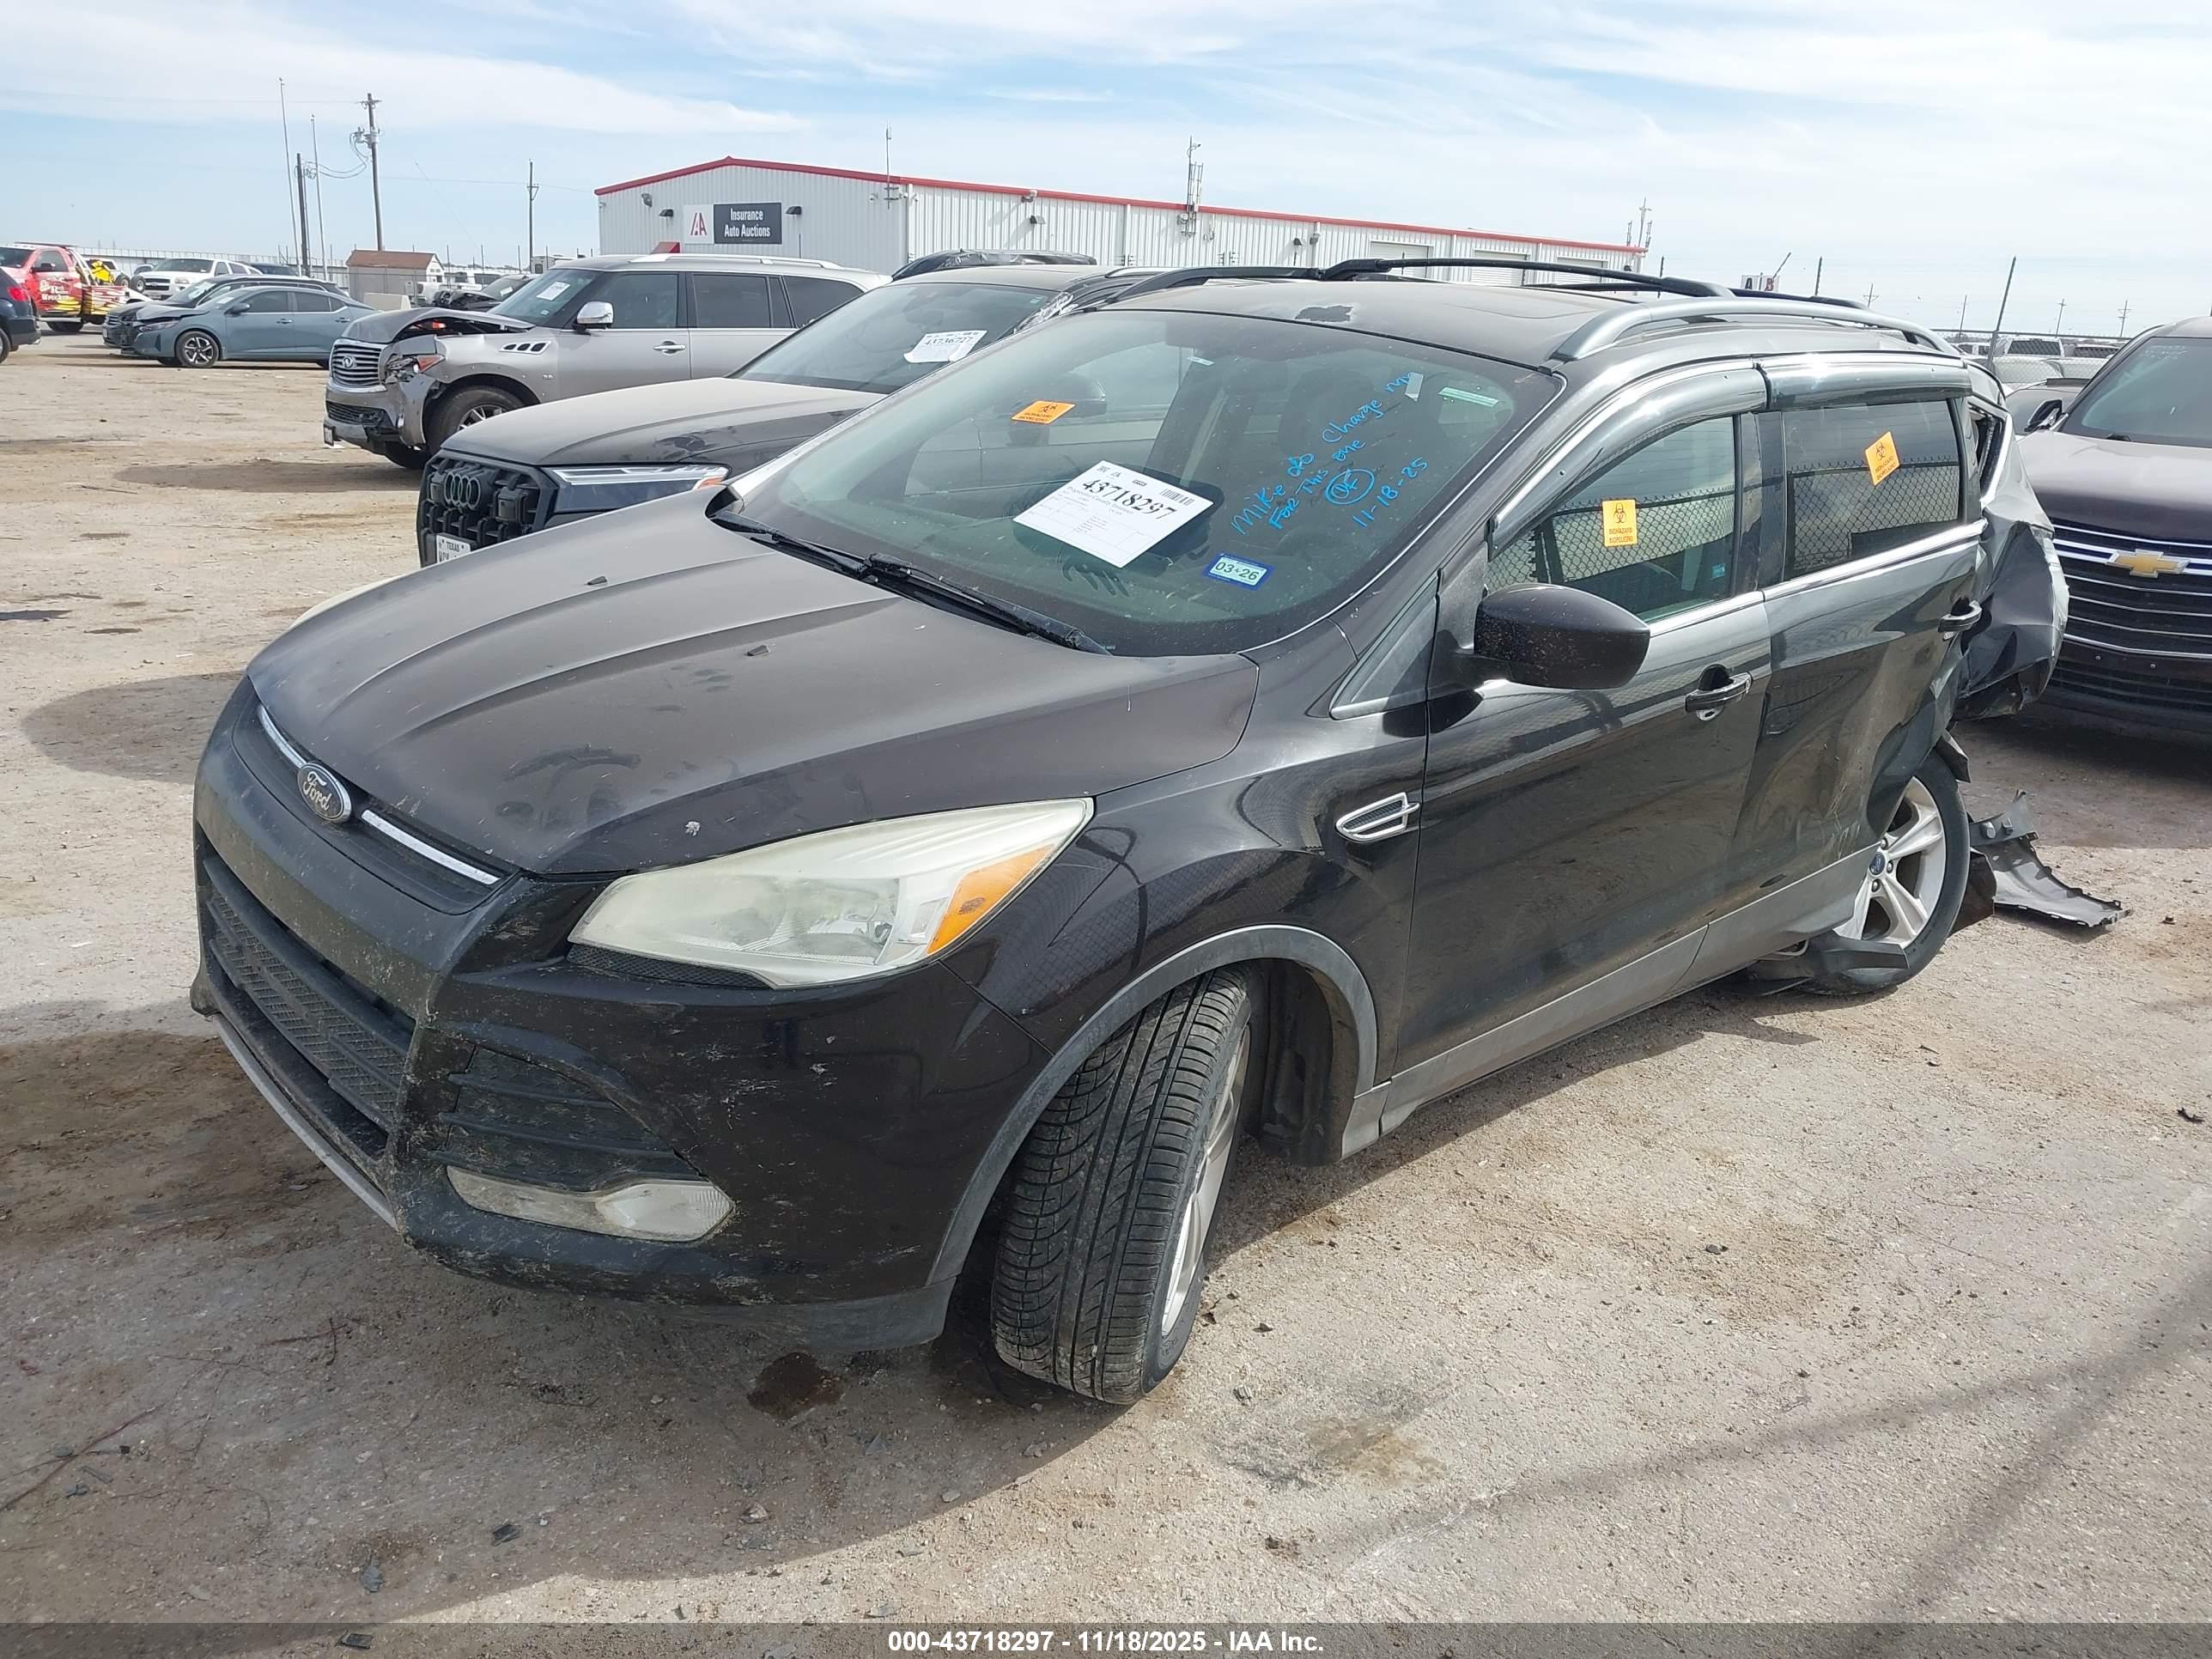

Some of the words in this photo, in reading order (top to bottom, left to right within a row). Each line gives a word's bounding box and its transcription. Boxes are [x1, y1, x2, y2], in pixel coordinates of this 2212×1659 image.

[729, 207, 764, 222] Insurance
[724, 224, 740, 238] Auto
[740, 223, 771, 238] Auctions
[1082, 478, 1178, 520] 43718297
[302, 771, 332, 811] Ford
